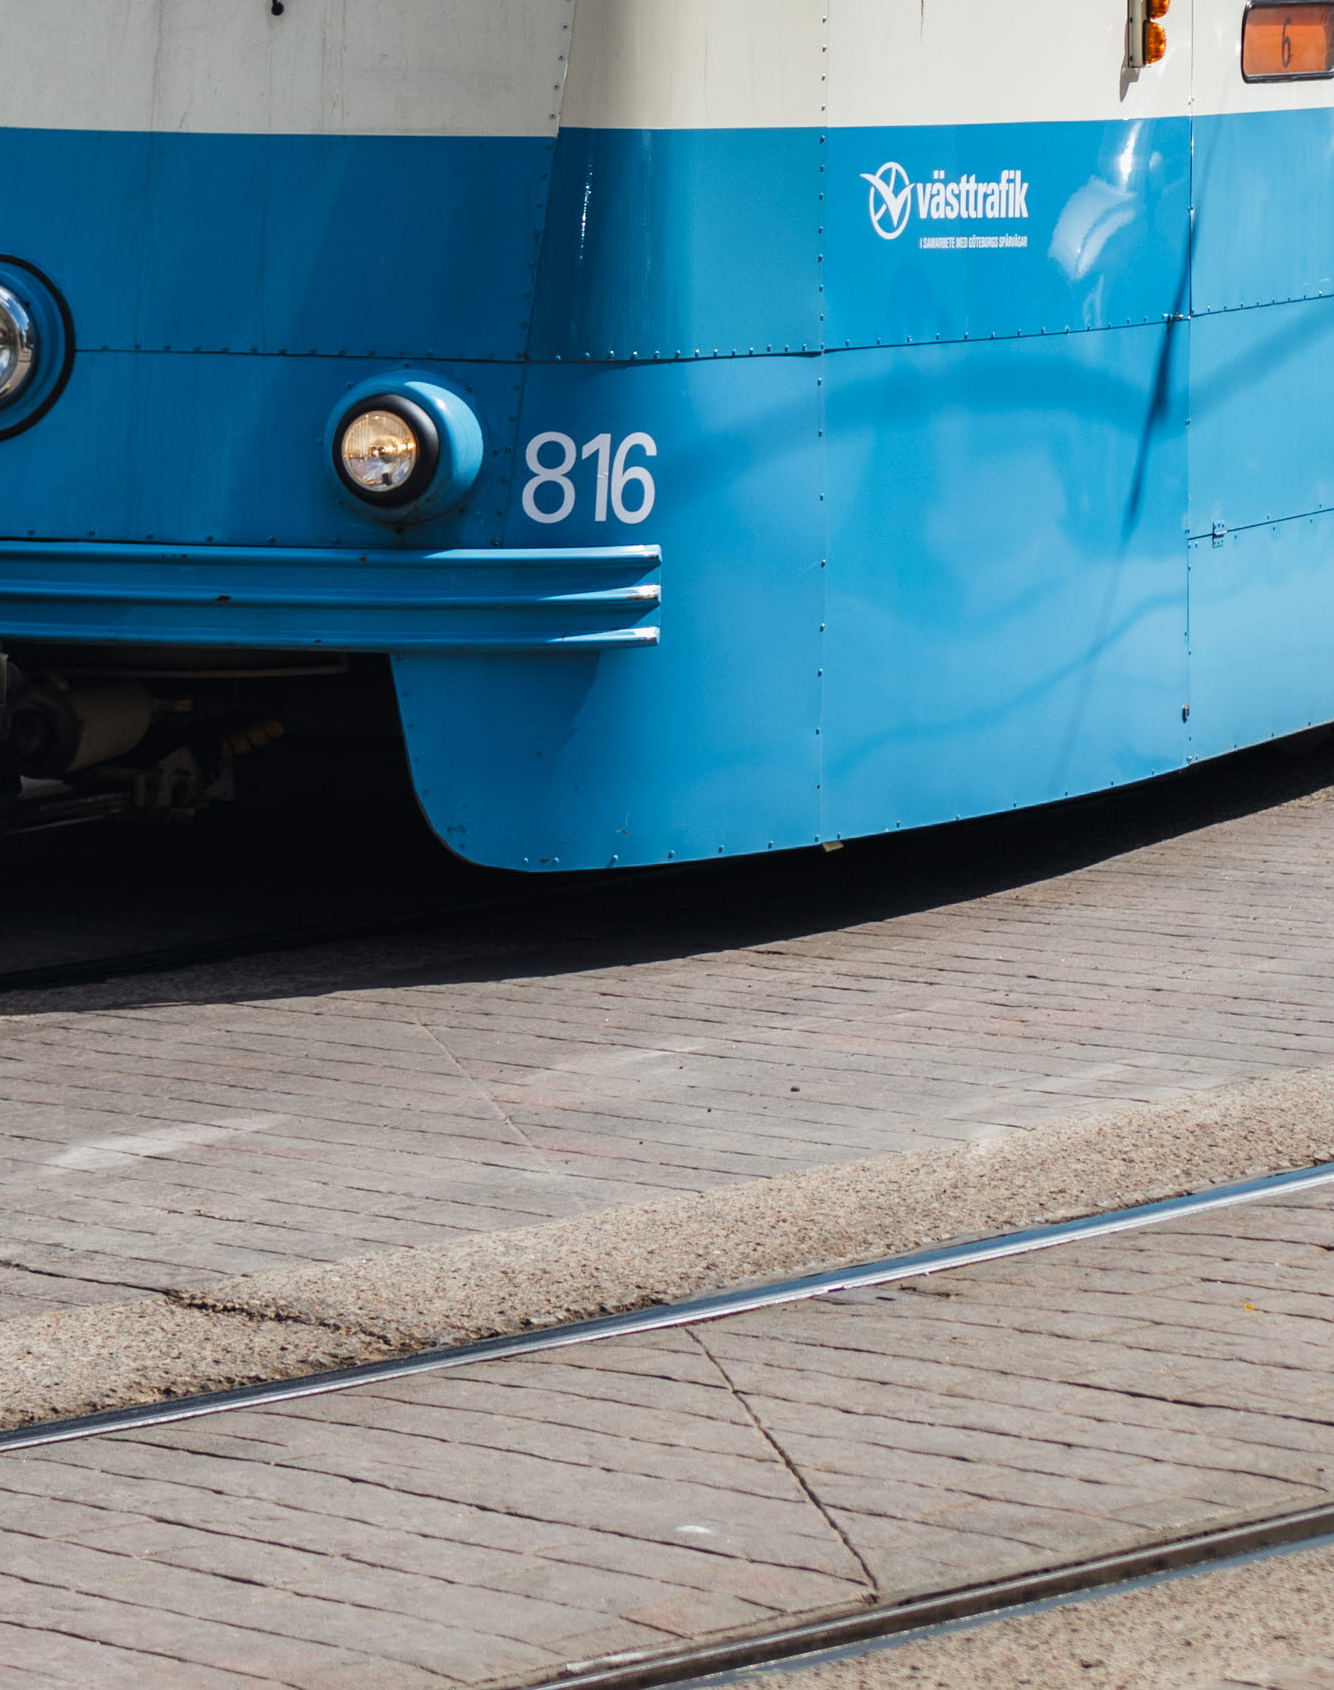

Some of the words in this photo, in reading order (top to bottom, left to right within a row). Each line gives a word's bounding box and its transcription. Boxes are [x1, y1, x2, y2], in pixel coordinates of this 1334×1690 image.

[1281, 14, 1292, 69] 6
[916, 169, 1029, 220] västtrafik
[923, 236, 956, 249] SAMARBETE
[956, 236, 968, 248] MED
[968, 234, 999, 248] GÖTEBORGS
[999, 232, 1028, 248] SPÅRVÄGAR
[521, 430, 658, 525] 816
